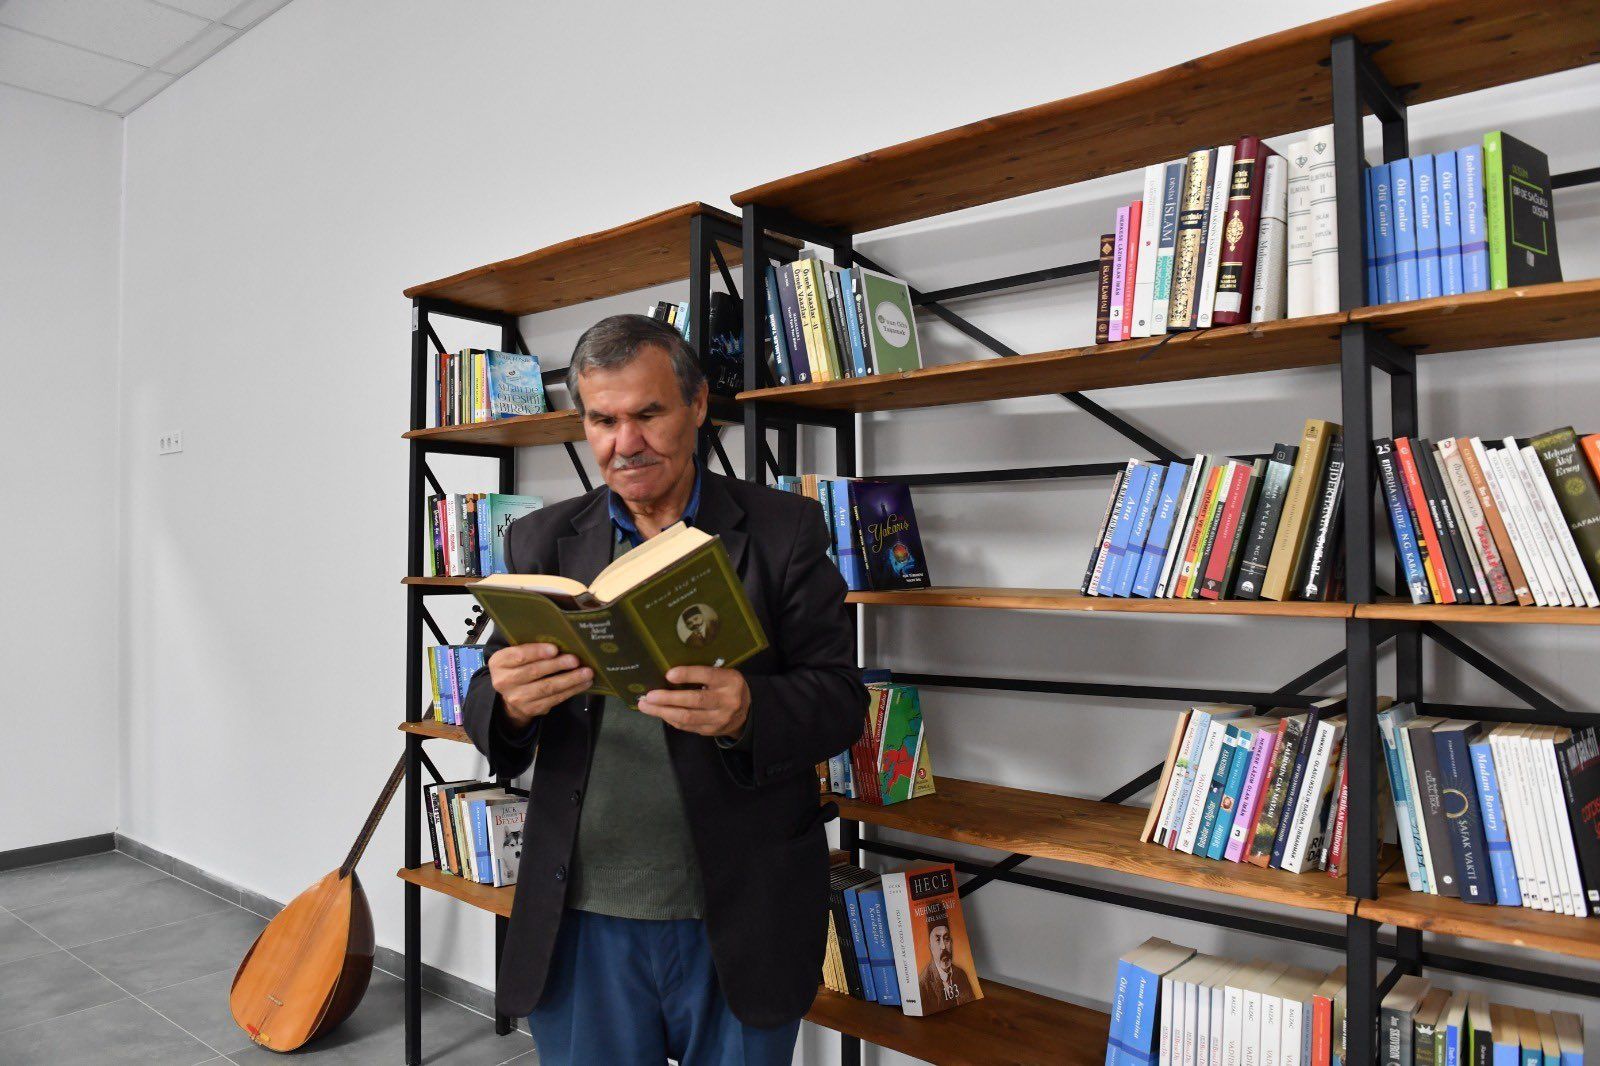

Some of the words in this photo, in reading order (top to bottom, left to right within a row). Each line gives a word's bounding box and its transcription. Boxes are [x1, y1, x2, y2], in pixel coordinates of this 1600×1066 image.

[1397, 178, 1406, 195] Ölü
[1419, 174, 1429, 191] Ölü
[1442, 171, 1452, 188] Ölü
[1465, 155, 1475, 198] Robinson
[1378, 184, 1387, 200] Ölü
[1160, 201, 1175, 242] İSLAM
[1379, 204, 1387, 236] Canlar
[1398, 198, 1408, 232] Canlar
[1420, 195, 1431, 228] Canlar
[1443, 192, 1453, 226] Canlar
[1468, 201, 1477, 234] Crusoe
[793, 268, 804, 289] Örnek
[802, 268, 814, 290] Örnek
[1255, 240, 1267, 290] Muhammed
[797, 290, 808, 318] Vaazlar
[806, 291, 816, 319] Vaazlar
[1114, 309, 1119, 317] 3
[1376, 444, 1390, 455] 25
[1543, 444, 1576, 461] Mehmed
[1555, 464, 1580, 477] Ersoy
[1144, 471, 1159, 504] Madam
[1121, 495, 1137, 521] Ana
[1158, 493, 1175, 520] Ana
[1380, 458, 1397, 493] EJDERHA
[1392, 502, 1406, 529] YILDIZ
[1405, 552, 1419, 577] KABAL
[868, 514, 910, 553] Yakarış
[1133, 506, 1149, 536] Bovary
[1197, 519, 1203, 528] VE
[1256, 502, 1270, 540] AYLEMA
[1253, 737, 1265, 764] HERKESE
[1316, 728, 1328, 756] DAWKINS
[1274, 777, 1283, 792] CAN
[1304, 760, 1320, 803] OLASILIKSIZLIK
[1477, 752, 1491, 791] Madam
[1243, 784, 1252, 800] OLAN
[1337, 784, 1350, 820] AMERİKAN
[1299, 804, 1309, 825] DAĞINA
[1483, 793, 1499, 831] Bovary
[1290, 825, 1303, 859] TIRMANMAK
[1332, 821, 1344, 855] KORİDORU
[914, 873, 948, 894] HECE
[914, 903, 940, 917] MEHMET
[852, 917, 861, 942] Canlar
[1118, 977, 1128, 992] Ölü
[1137, 977, 1148, 999] Anna
[1113, 993, 1125, 1022] Canlar
[1132, 1001, 1145, 1039] Karenina
